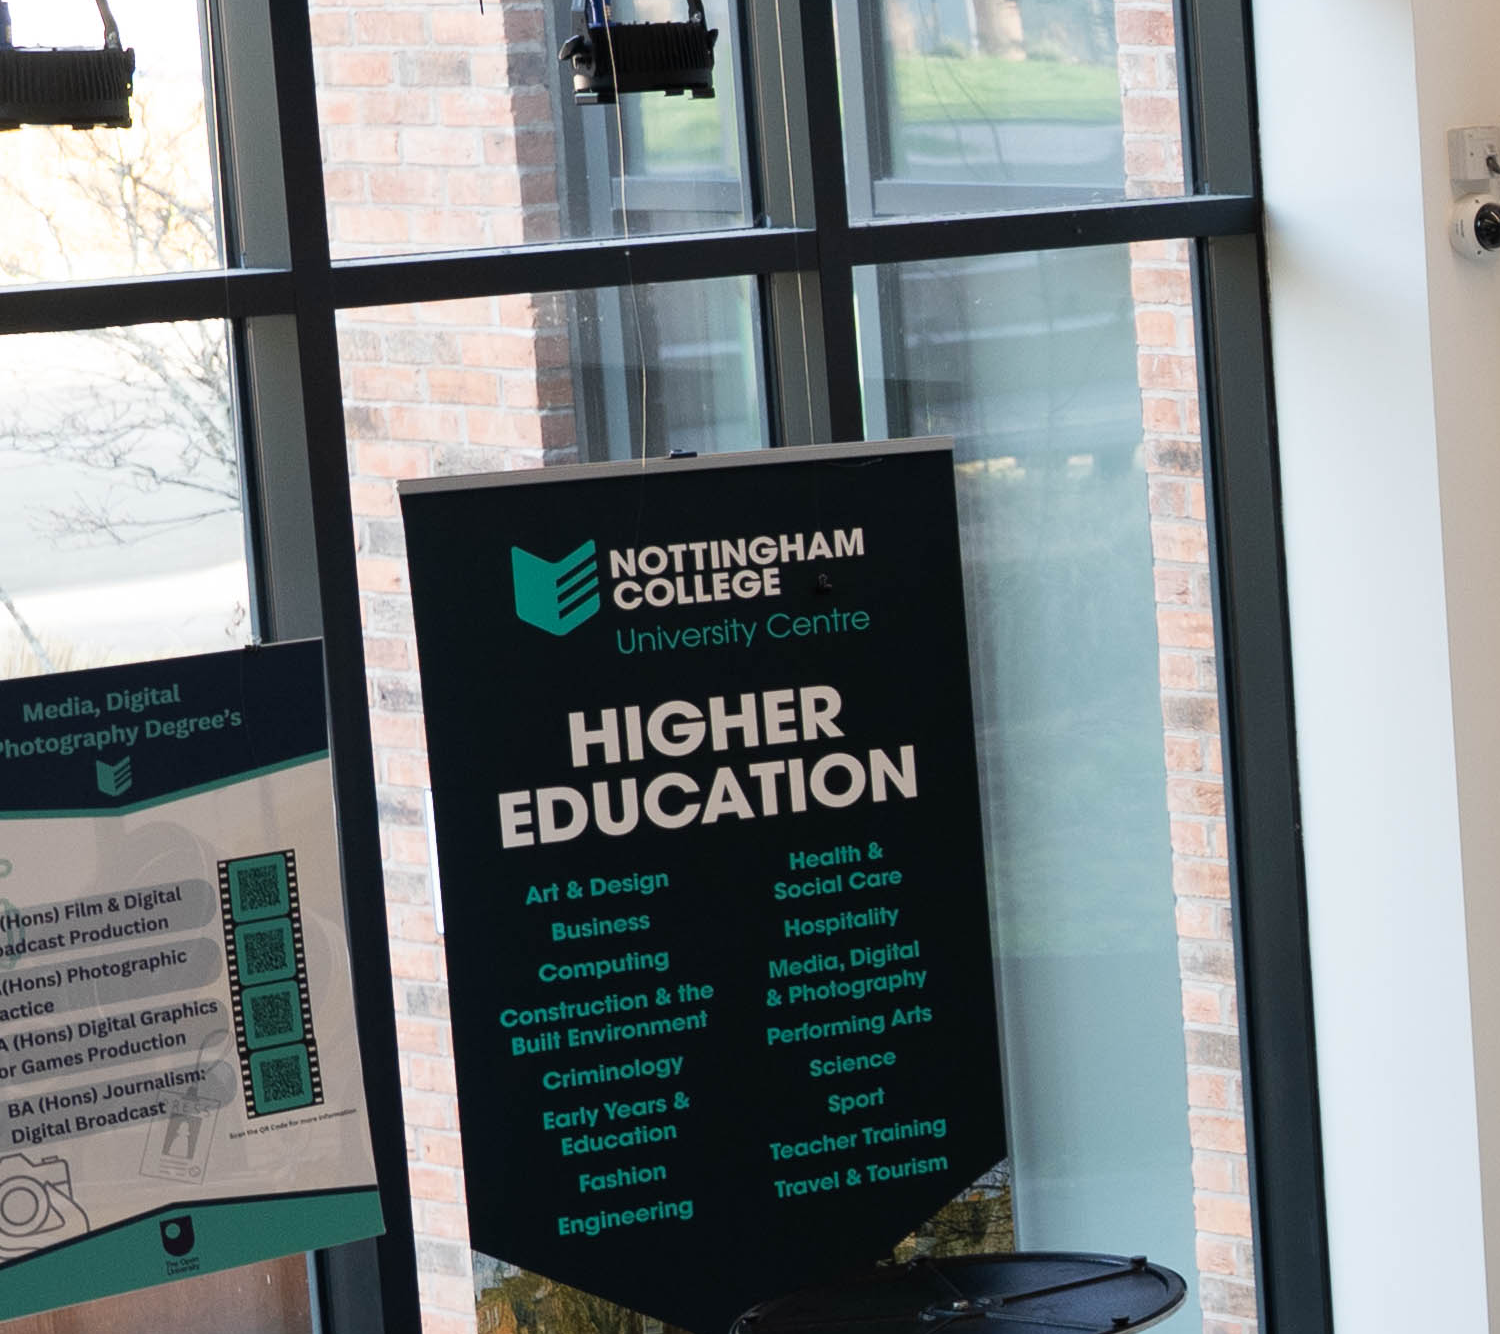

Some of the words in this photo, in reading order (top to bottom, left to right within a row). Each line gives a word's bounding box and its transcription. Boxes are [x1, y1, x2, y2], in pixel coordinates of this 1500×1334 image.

[609, 527, 865, 580] NOTTINGHAM
[612, 567, 782, 612] COLLEGE
[615, 617, 758, 655] University
[766, 607, 871, 641] Centre
[22, 696, 101, 723] Media,
[106, 683, 181, 713] Digital
[0, 724, 140, 759] hotography
[145, 709, 243, 740] Degree's
[568, 684, 845, 769] HIGHER
[498, 744, 919, 849] EDUCATION
[789, 845, 861, 871] Health
[867, 841, 883, 860] &
[525, 884, 560, 906] Art
[566, 880, 583, 900] &
[589, 872, 669, 897] Design
[774, 874, 843, 900] Social
[849, 870, 903, 890] Care
[0, 907, 60, 933] (Hons)
[64, 901, 104, 921] Film
[107, 897, 120, 912] &
[124, 886, 183, 910] Digital
[551, 914, 651, 942] Business
[784, 906, 899, 938] Hospitality
[69, 917, 169, 945] Production
[67, 949, 188, 983] Photographic
[538, 951, 670, 983] Computing
[768, 953, 846, 979] Media,
[849, 939, 920, 968] Digital
[499, 993, 649, 1028] Construction
[655, 987, 671, 1006] &
[677, 983, 714, 1003] the
[766, 989, 782, 1007] &
[788, 969, 927, 1004] Photography
[13, 1026, 73, 1051] (Hons)
[78, 1013, 136, 1039] Digital
[140, 999, 219, 1026] Graphics
[511, 1030, 561, 1057] Built
[567, 1010, 708, 1048] Environment
[767, 1015, 885, 1046] Performing
[891, 1005, 933, 1027] Arts
[21, 1053, 84, 1076] Games
[87, 1032, 187, 1062] Production
[542, 1056, 684, 1090] Criminology
[809, 1050, 897, 1077] Science
[7, 1101, 34, 1119] BA
[38, 1087, 98, 1114] (Hons)
[102, 1068, 206, 1100] Journalism:
[542, 1106, 599, 1131] Early
[603, 1097, 667, 1120] Years
[673, 1091, 690, 1110] &
[827, 1086, 885, 1115] Sport
[11, 1118, 72, 1145] Digital
[75, 1101, 167, 1132] Broadcast
[259, 1126, 269, 1134] QR
[270, 1122, 288, 1131] Code
[561, 1124, 678, 1156] Education
[769, 1133, 858, 1161] Teacher
[861, 1118, 947, 1146] Training
[578, 1165, 667, 1194] Fashion
[774, 1171, 840, 1199] Travel
[846, 1168, 862, 1187] &
[866, 1156, 949, 1183] Tourism
[558, 1200, 694, 1237] Engineering
